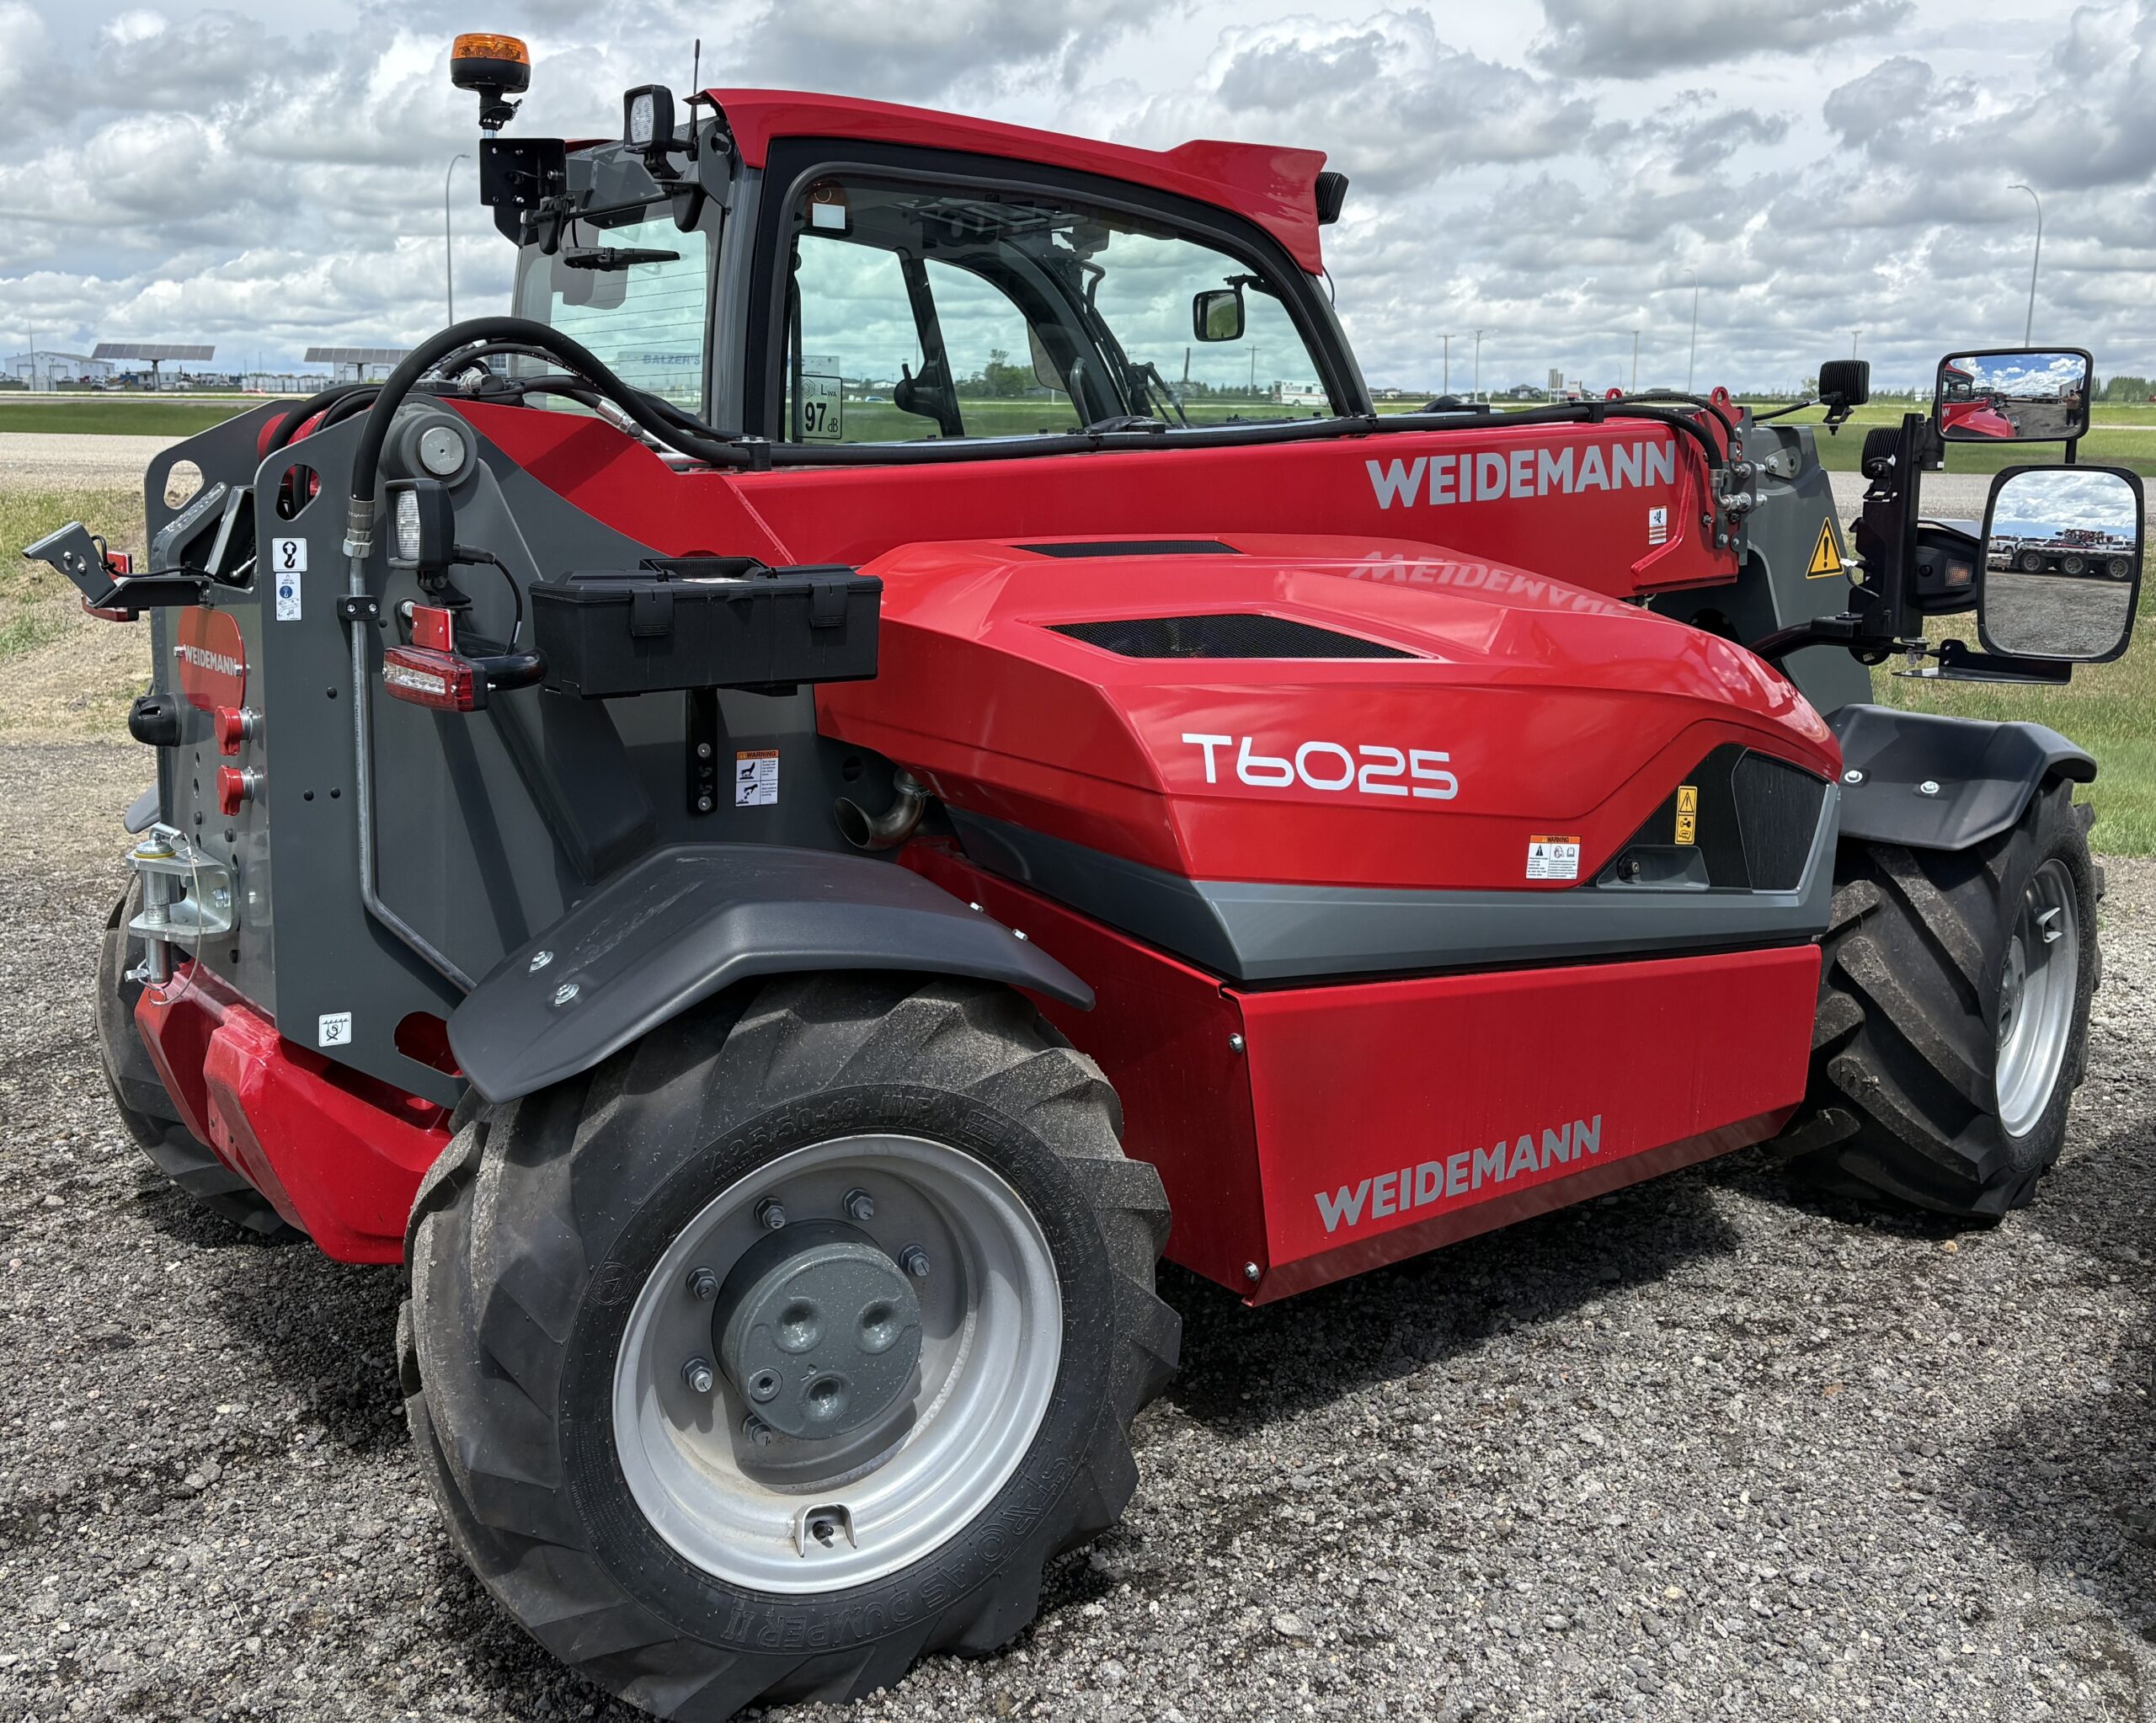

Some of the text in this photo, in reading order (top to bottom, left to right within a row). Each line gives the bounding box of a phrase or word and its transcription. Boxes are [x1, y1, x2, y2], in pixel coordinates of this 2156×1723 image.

[643, 355, 701, 365] BALZER'S
[804, 402, 839, 433] 97 dB
[1365, 440, 1676, 509] WEIDEMANN
[184, 644, 237, 677] WEIDEMANN
[1181, 733, 1459, 800] T6025
[1314, 1113, 1602, 1233] WEIDEMANN
[921, 1553, 968, 1610] AS
[757, 1588, 915, 1649] DUMPER
